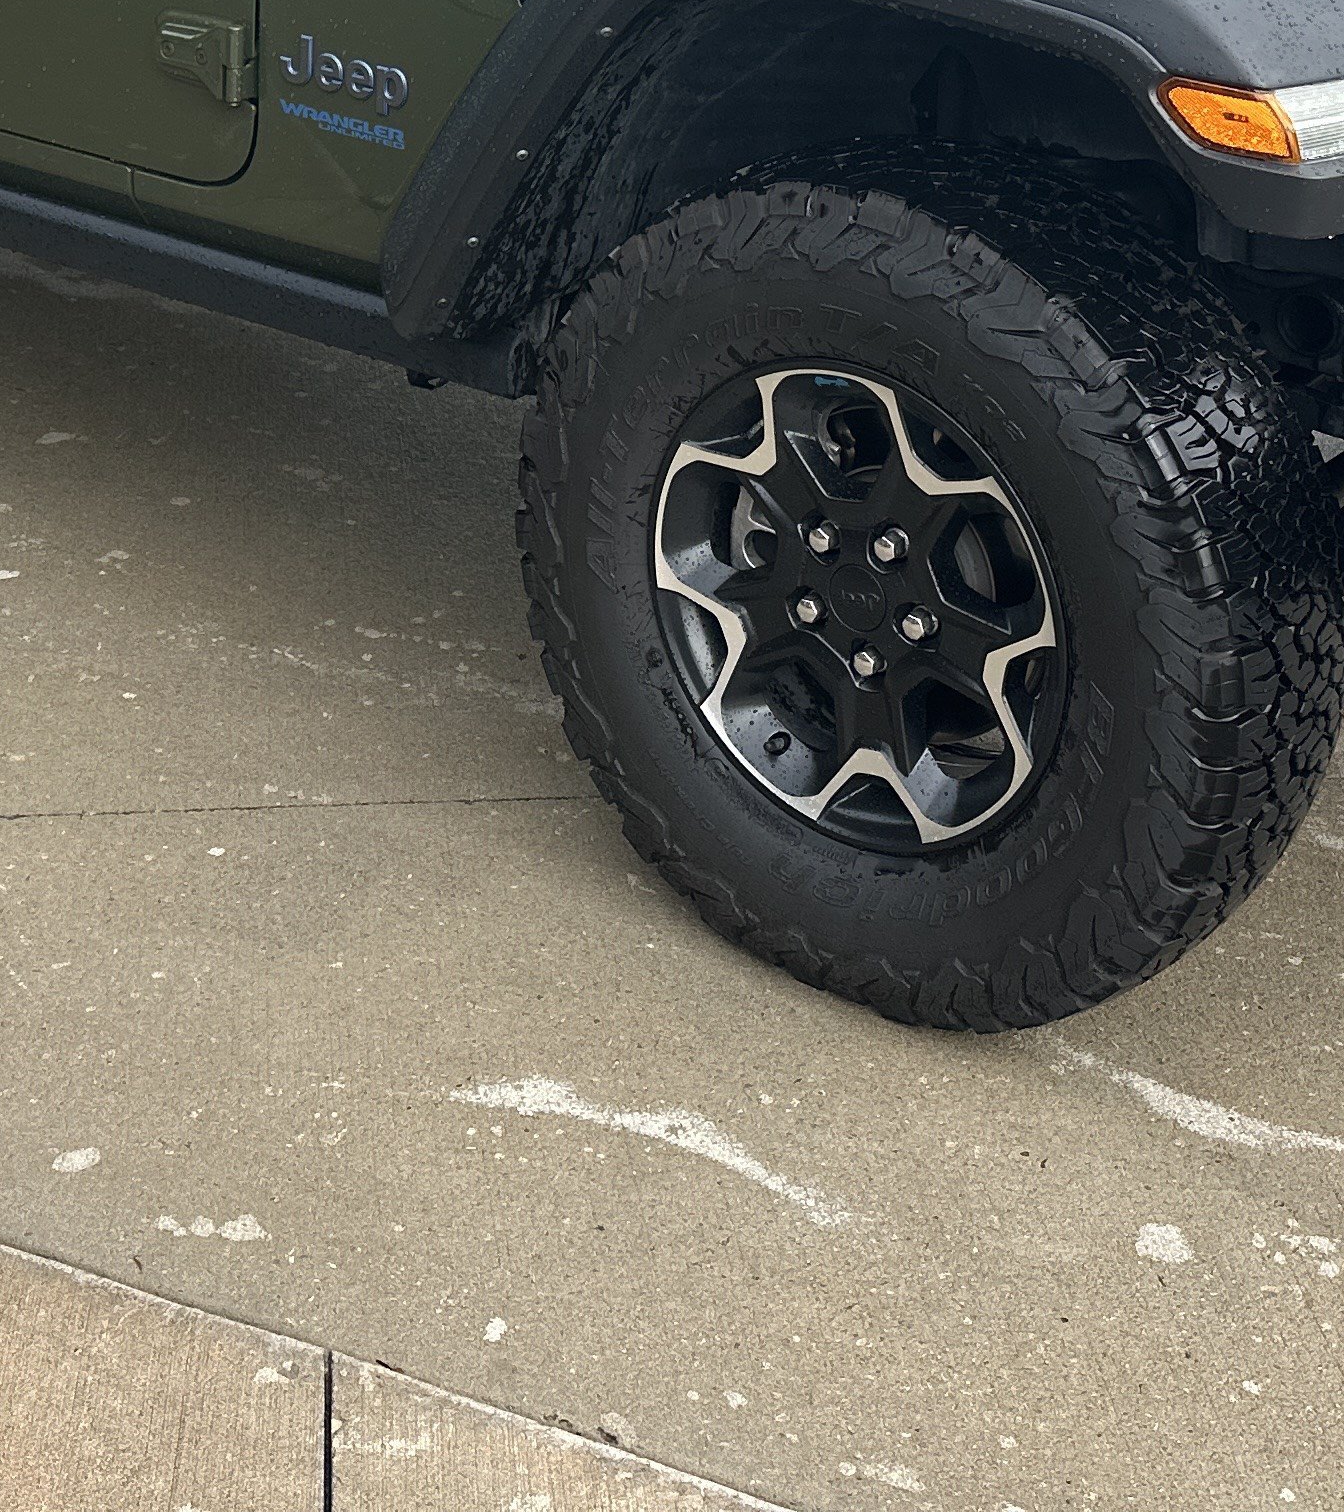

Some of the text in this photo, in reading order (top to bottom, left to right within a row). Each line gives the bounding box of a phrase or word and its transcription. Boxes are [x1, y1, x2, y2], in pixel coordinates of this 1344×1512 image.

[279, 34, 408, 116] Jeep
[279, 98, 405, 142] WRANGLER
[317, 122, 405, 150] UNLIMITED
